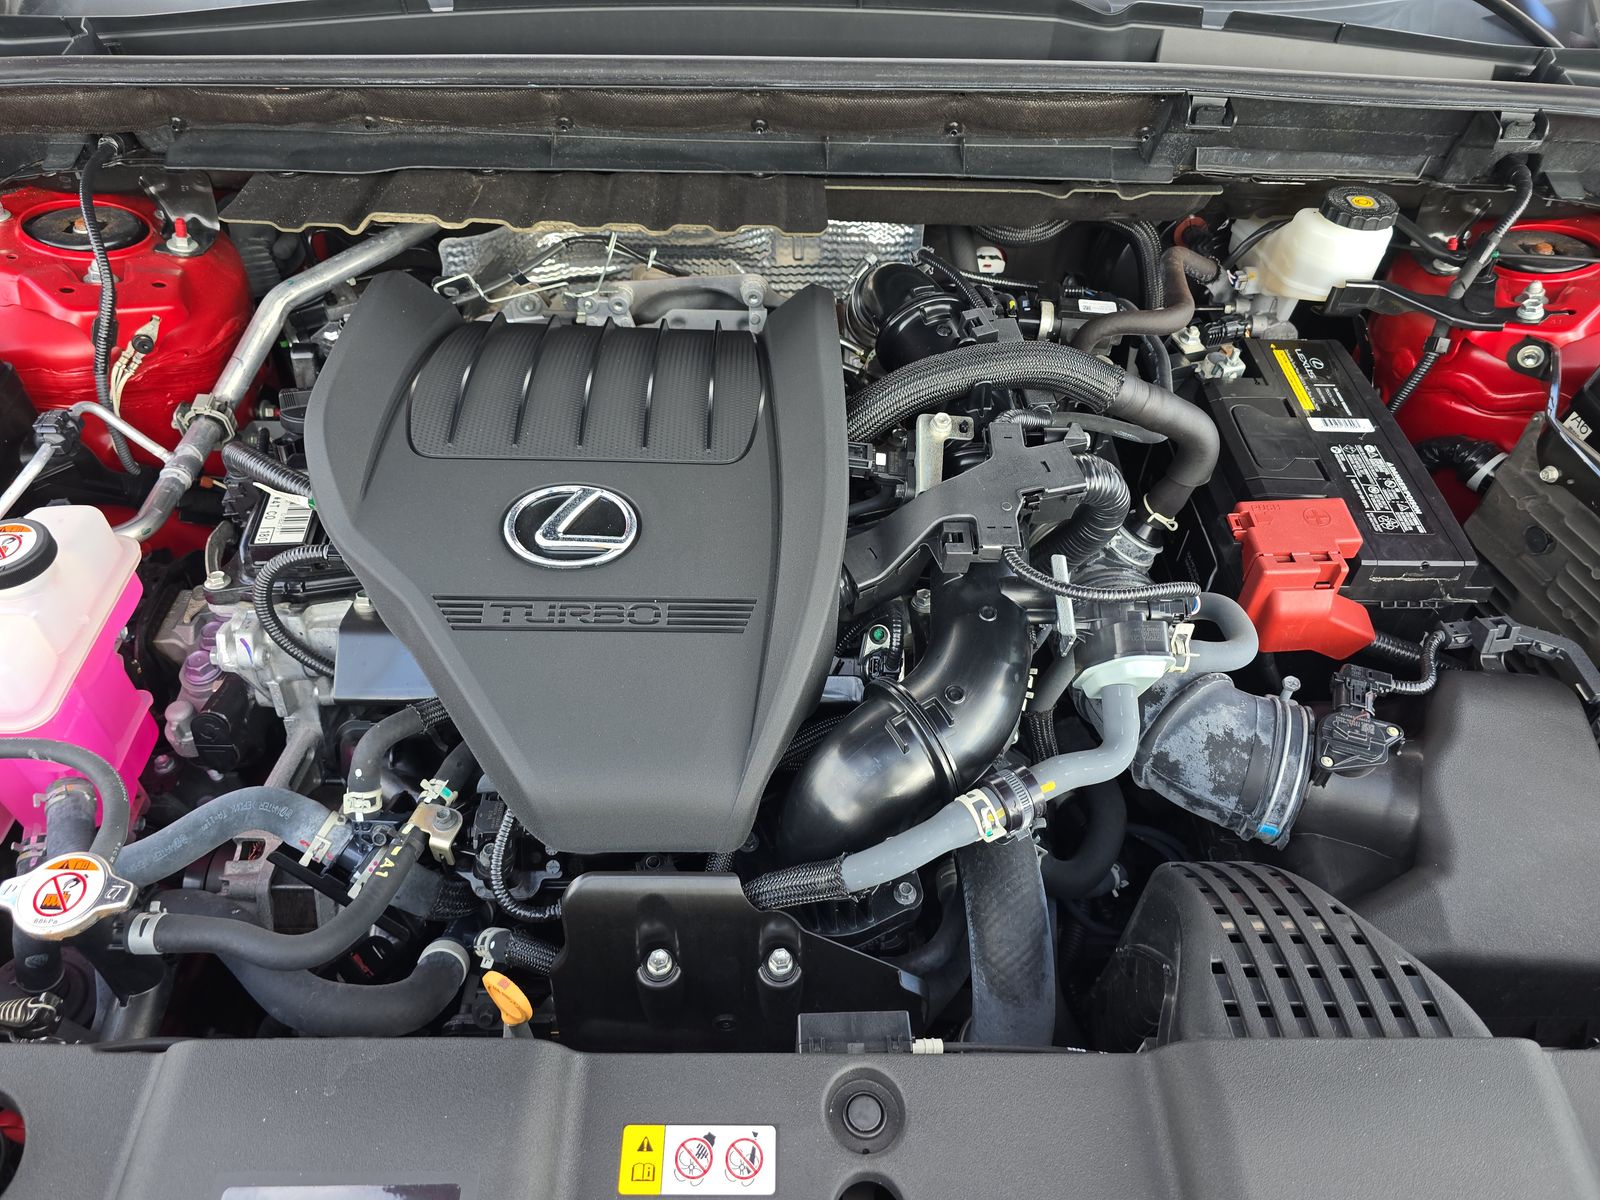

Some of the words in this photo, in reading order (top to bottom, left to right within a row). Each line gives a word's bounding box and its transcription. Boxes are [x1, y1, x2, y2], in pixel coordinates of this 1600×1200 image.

[1295, 348, 1317, 379] LEXUS
[489, 601, 662, 627] TURBO
[374, 857, 396, 878] A1
